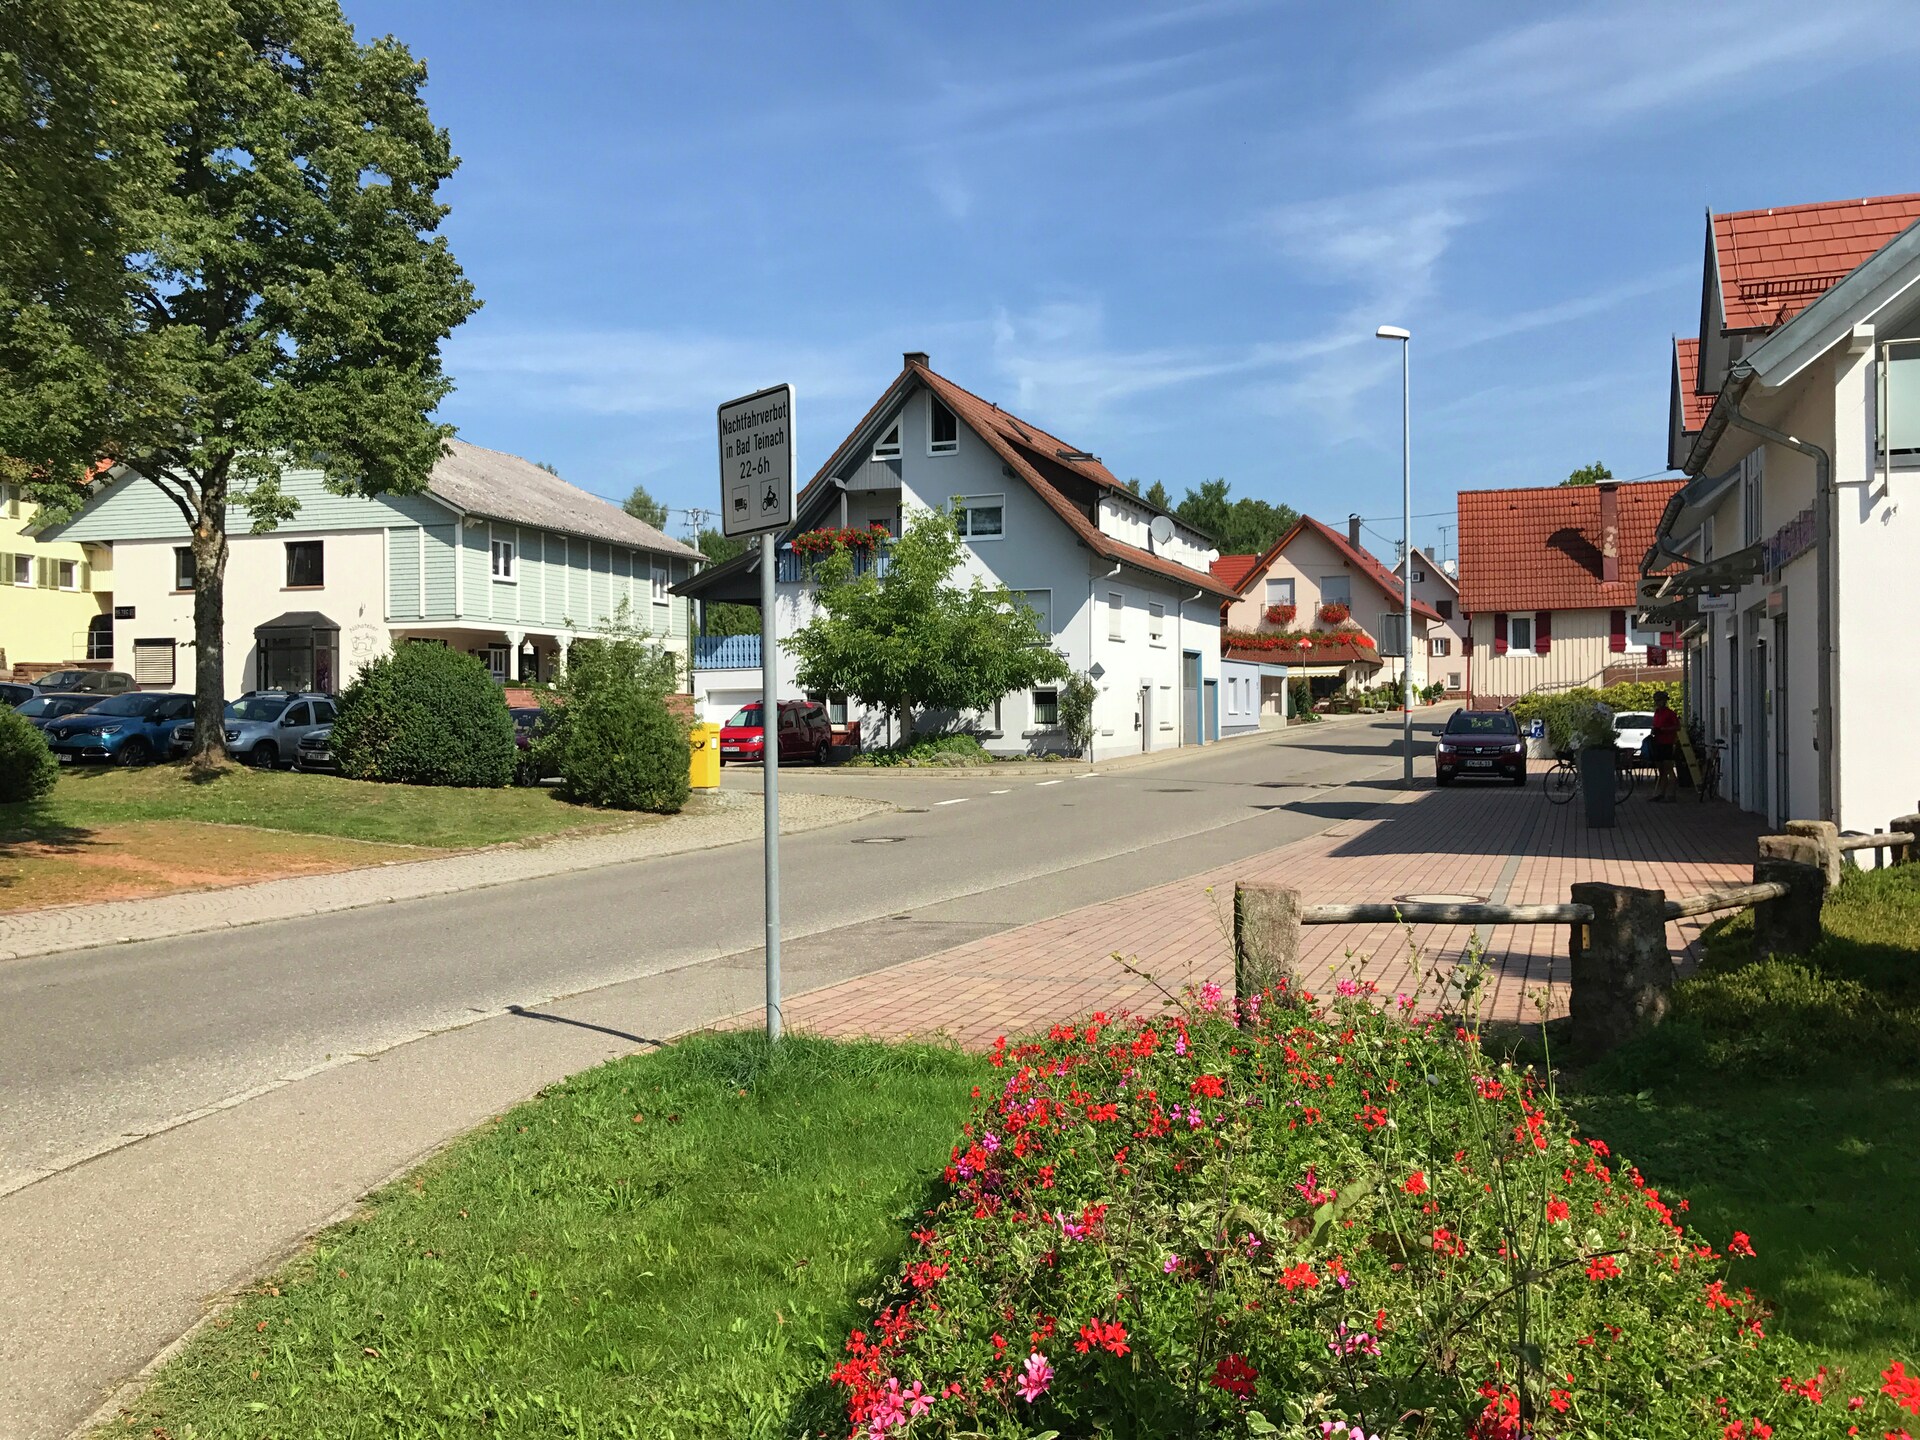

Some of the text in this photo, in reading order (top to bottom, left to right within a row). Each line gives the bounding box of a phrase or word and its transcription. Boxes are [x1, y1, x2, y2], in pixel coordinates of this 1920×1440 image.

[722, 402, 786, 435] Nachtfahrverbot
[726, 427, 784, 459] in Bad Teinach
[740, 456, 770, 479] 22-6h
[1531, 719, 1543, 733] P
